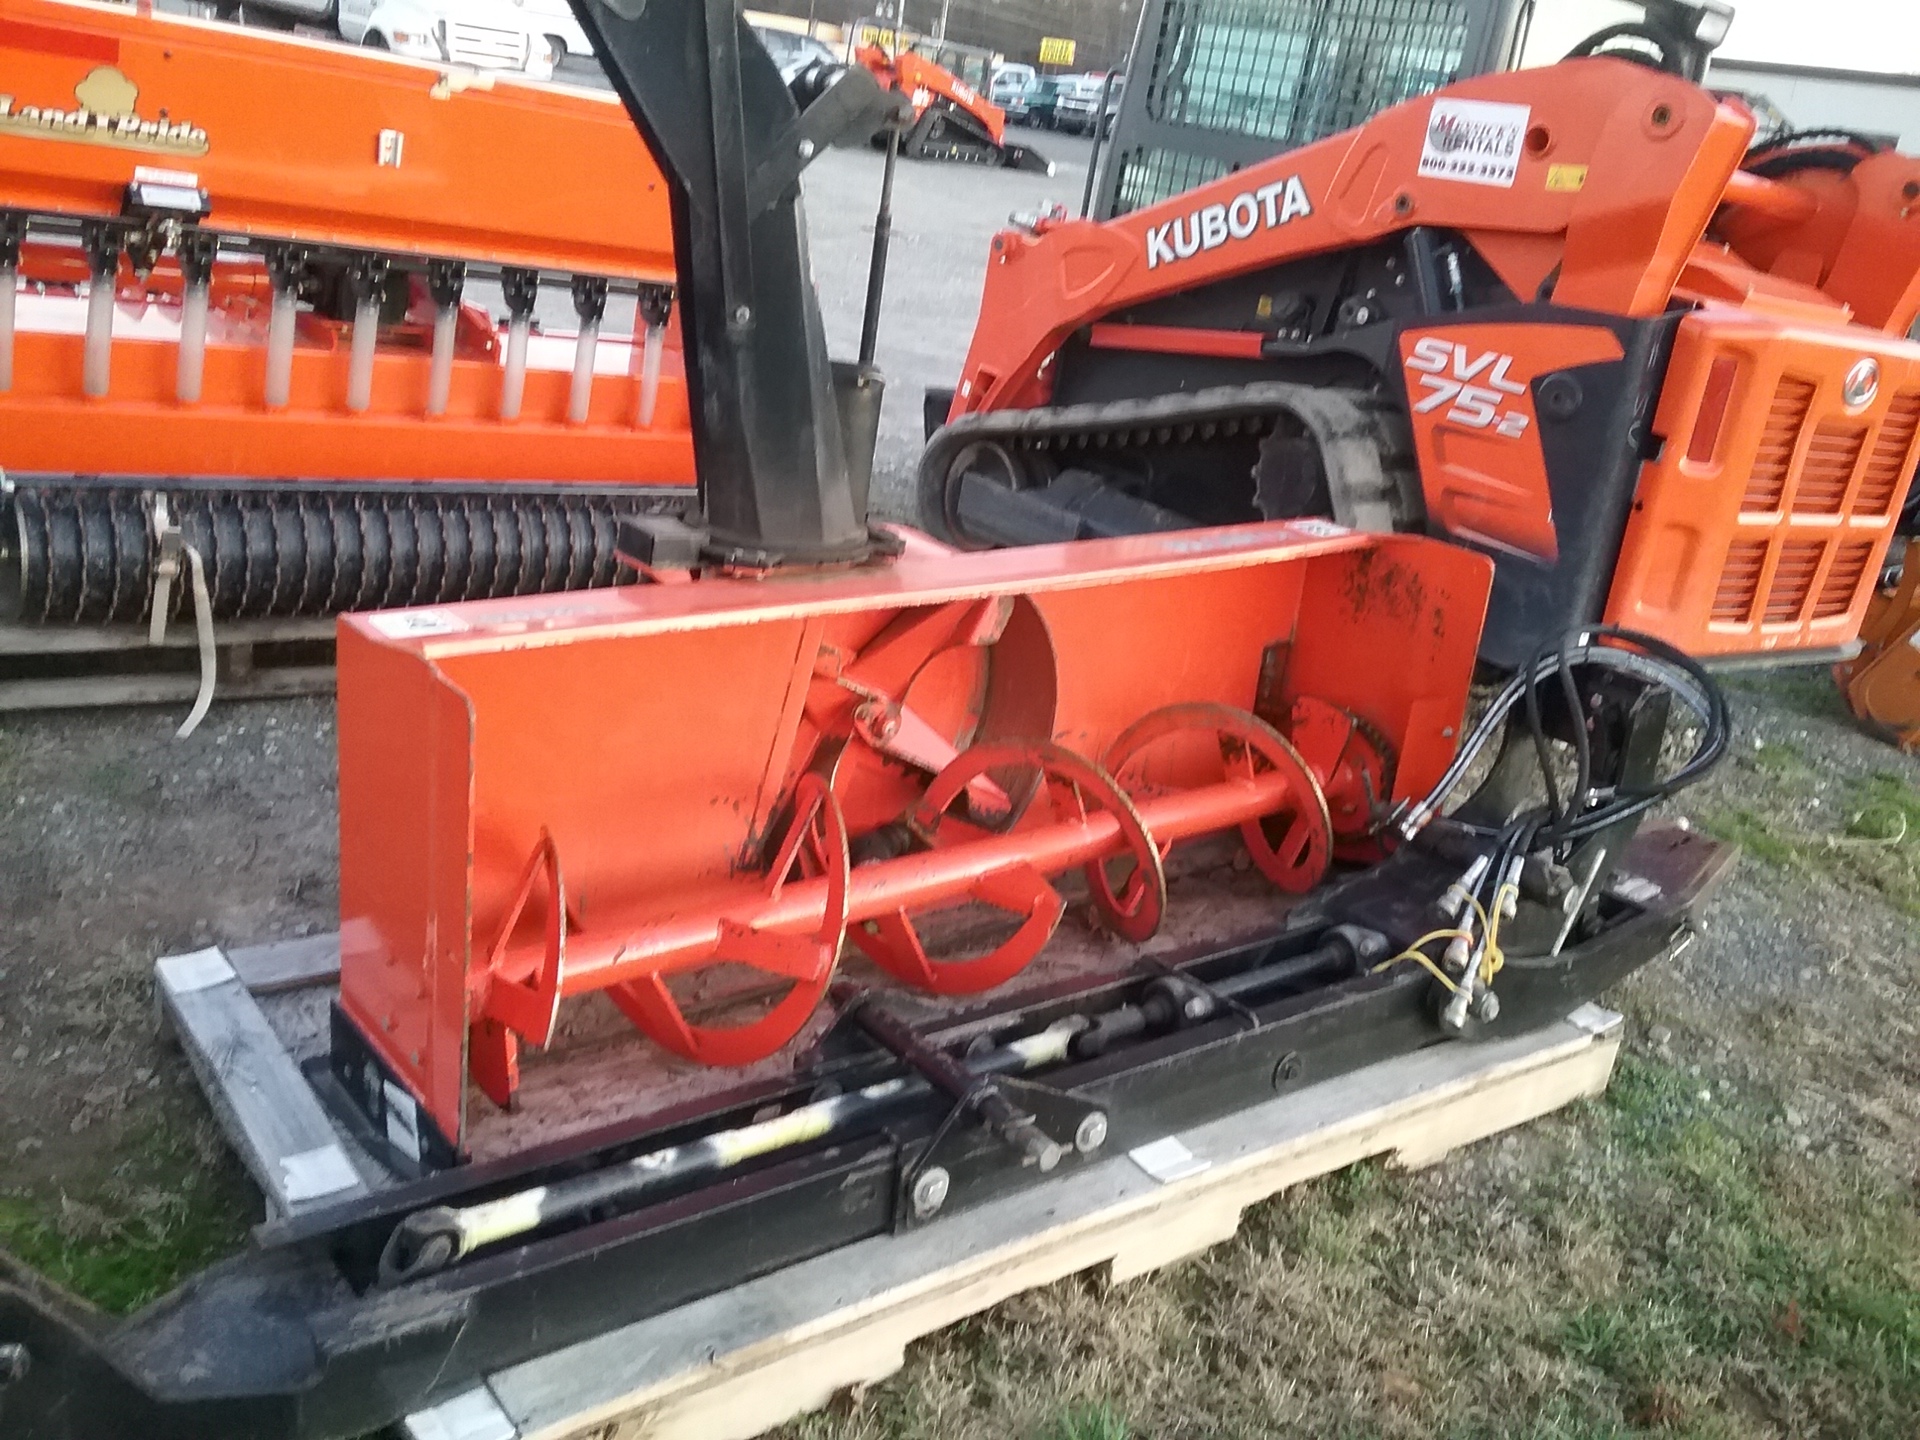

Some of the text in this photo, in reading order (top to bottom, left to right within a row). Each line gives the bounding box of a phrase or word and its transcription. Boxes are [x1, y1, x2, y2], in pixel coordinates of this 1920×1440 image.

[0, 94, 208, 147] Land Pride
[1442, 134, 1516, 158] RENTALS
[1146, 174, 1312, 270] KUBOTA
[1405, 336, 1528, 396] SVL
[1412, 373, 1530, 439] 75-2
